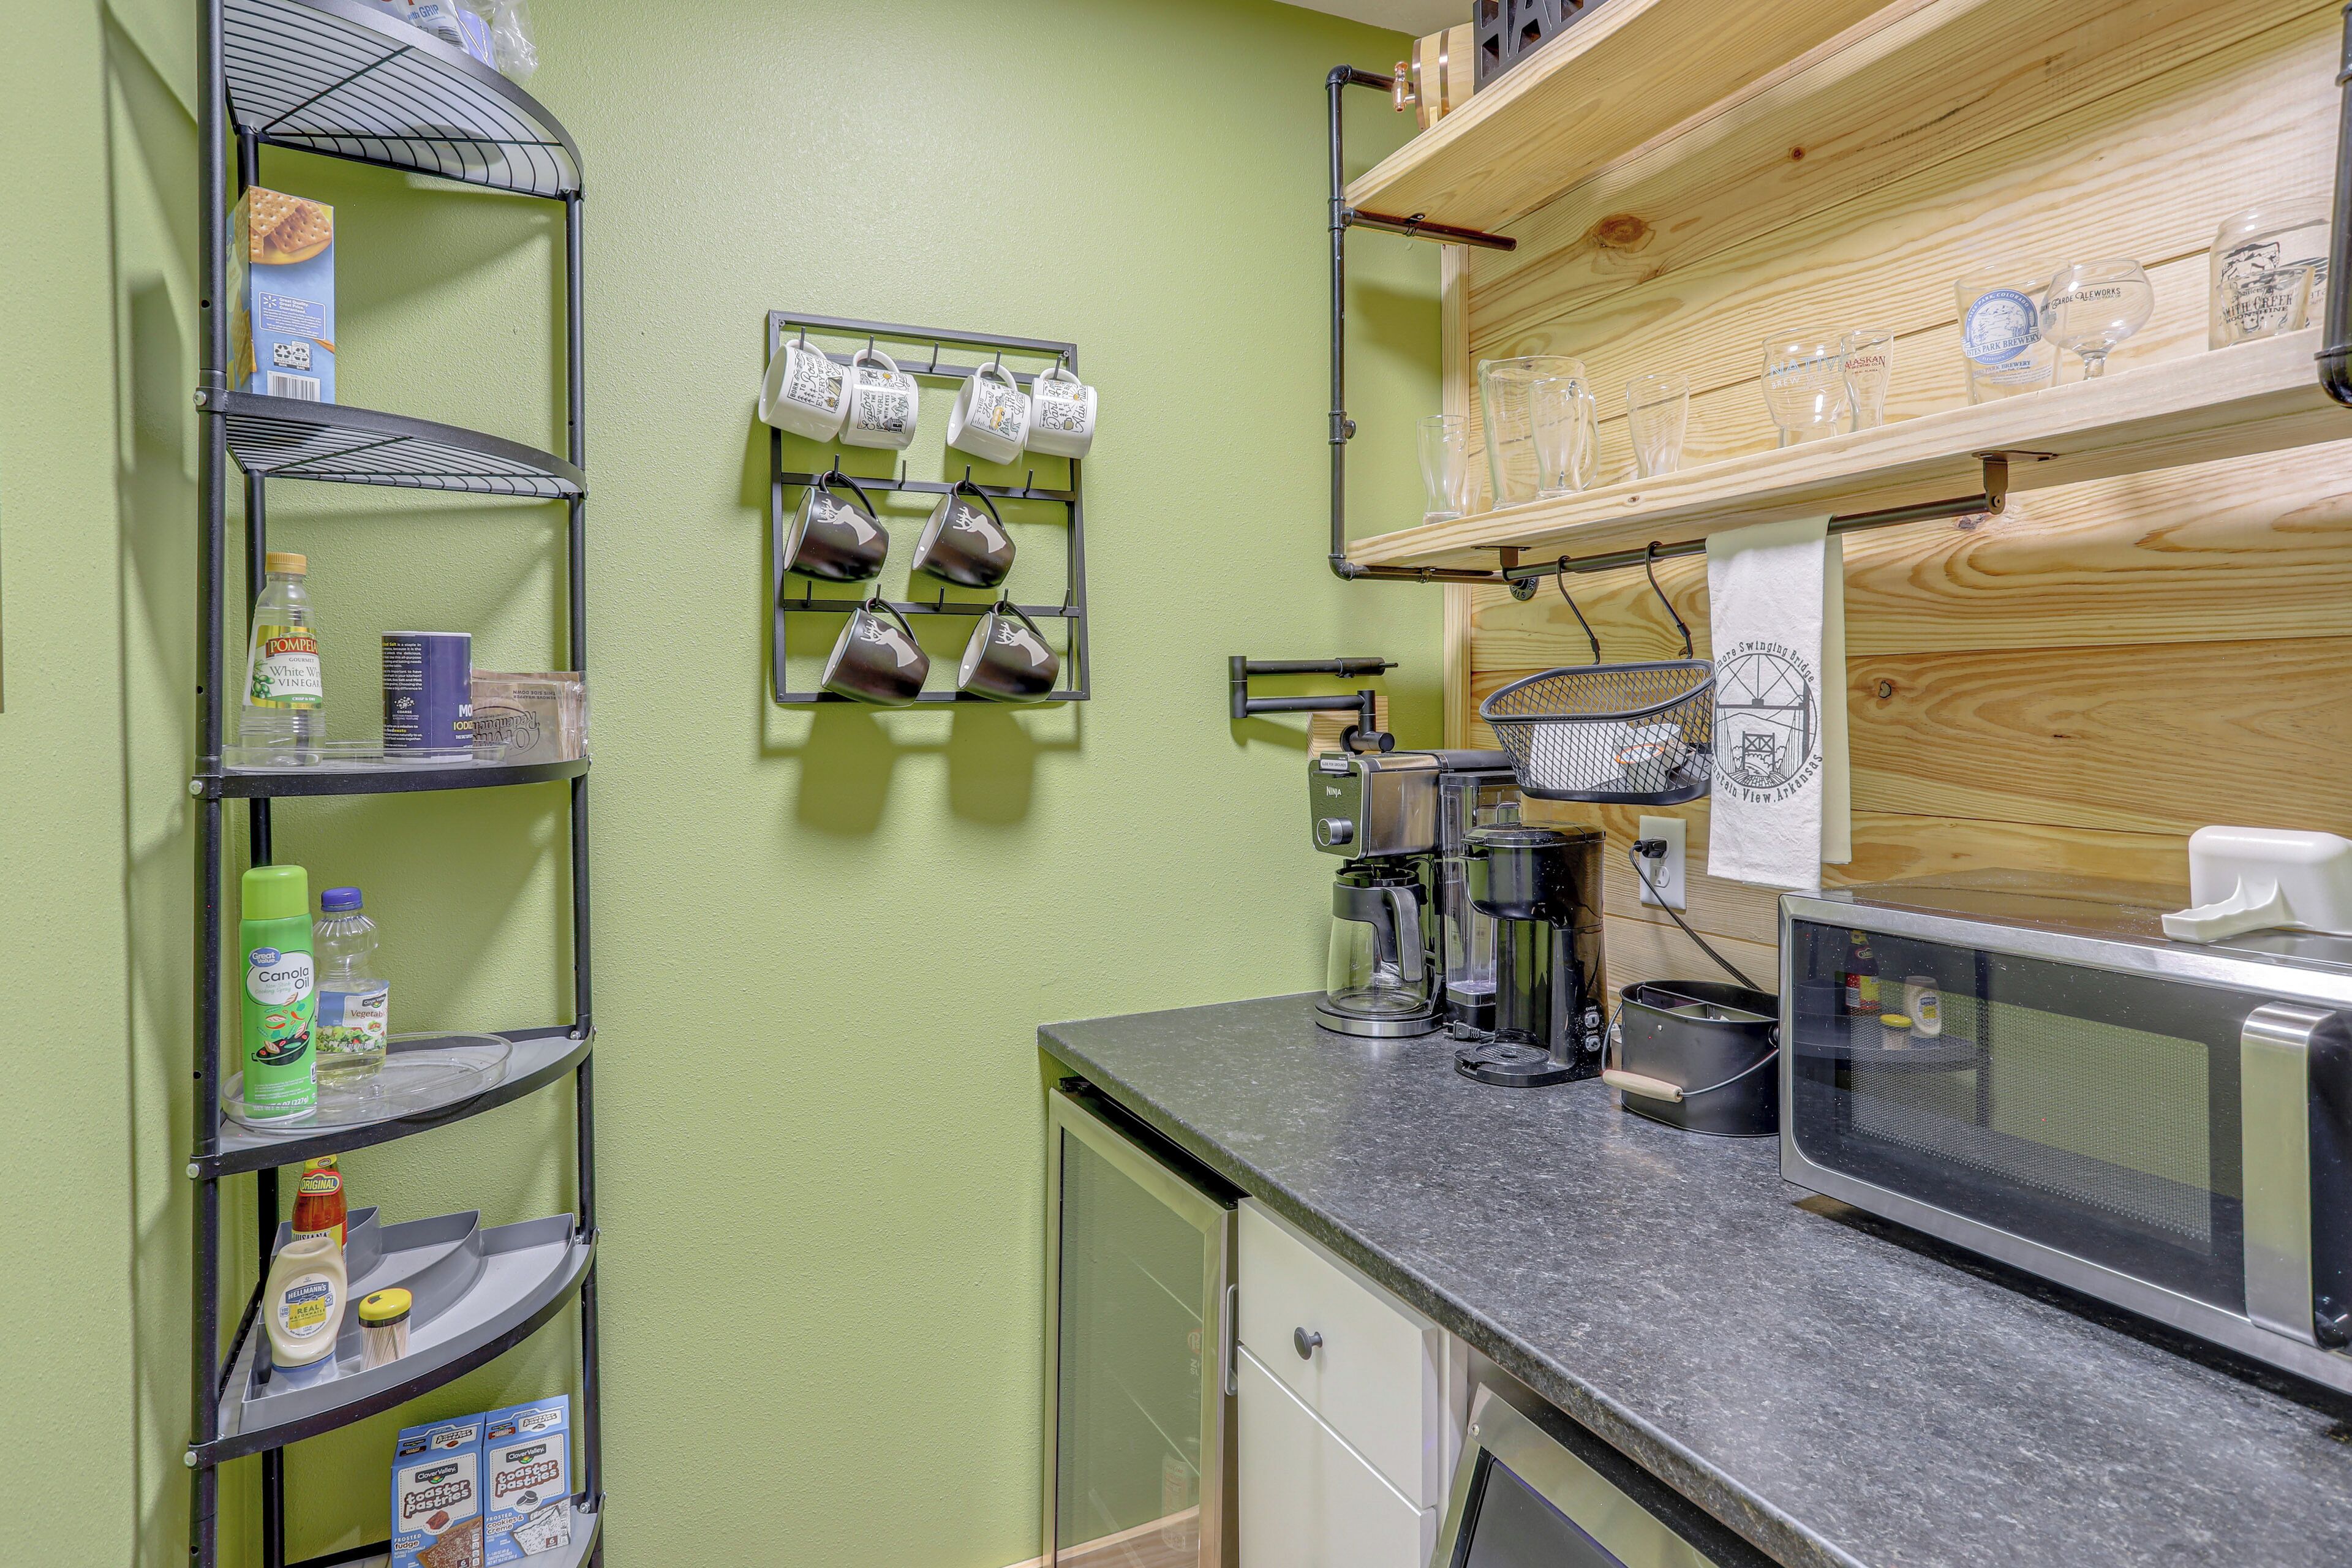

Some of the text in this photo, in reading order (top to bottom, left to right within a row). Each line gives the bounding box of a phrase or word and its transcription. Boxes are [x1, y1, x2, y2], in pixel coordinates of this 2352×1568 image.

[419, 4, 439, 18] GRIP
[1996, 292, 2029, 307] COLORADO
[2051, 288, 2121, 309] GARDE ALEWORKS
[1967, 332, 2040, 357] ESTES PARK BREWERY
[1844, 356, 1886, 373] ALASKAN
[2002, 360, 2031, 369] BREWERY
[1772, 376, 1800, 389] BREW
[790, 382, 799, 398] BORN
[982, 390, 994, 418] Heart
[1739, 641, 1788, 657] Swinging
[1790, 650, 1814, 683] Bridge
[270, 665, 304, 677] White
[279, 678, 321, 688] VINEGAR
[1777, 754, 1823, 801] Arkansas
[1326, 785, 1342, 798] NINJA
[259, 967, 309, 982] Canola
[295, 976, 309, 989] Oil
[301, 1178, 336, 1190] ORIGINAL
[288, 1283, 326, 1300] HELLMANN'S
[297, 1305, 320, 1314] REAL
[508, 1450, 527, 1460] Clover
[418, 1471, 437, 1479] Clover
[497, 1461, 556, 1483] toaster
[496, 1468, 557, 1495] pastries
[405, 1480, 469, 1504] toaster
[405, 1488, 469, 1517] pastries
[486, 1512, 513, 1521] FROSTED
[486, 1517, 517, 1529] cookies
[486, 1523, 513, 1535] creme
[394, 1533, 422, 1543] FROSTED
[394, 1540, 420, 1550] fudge
